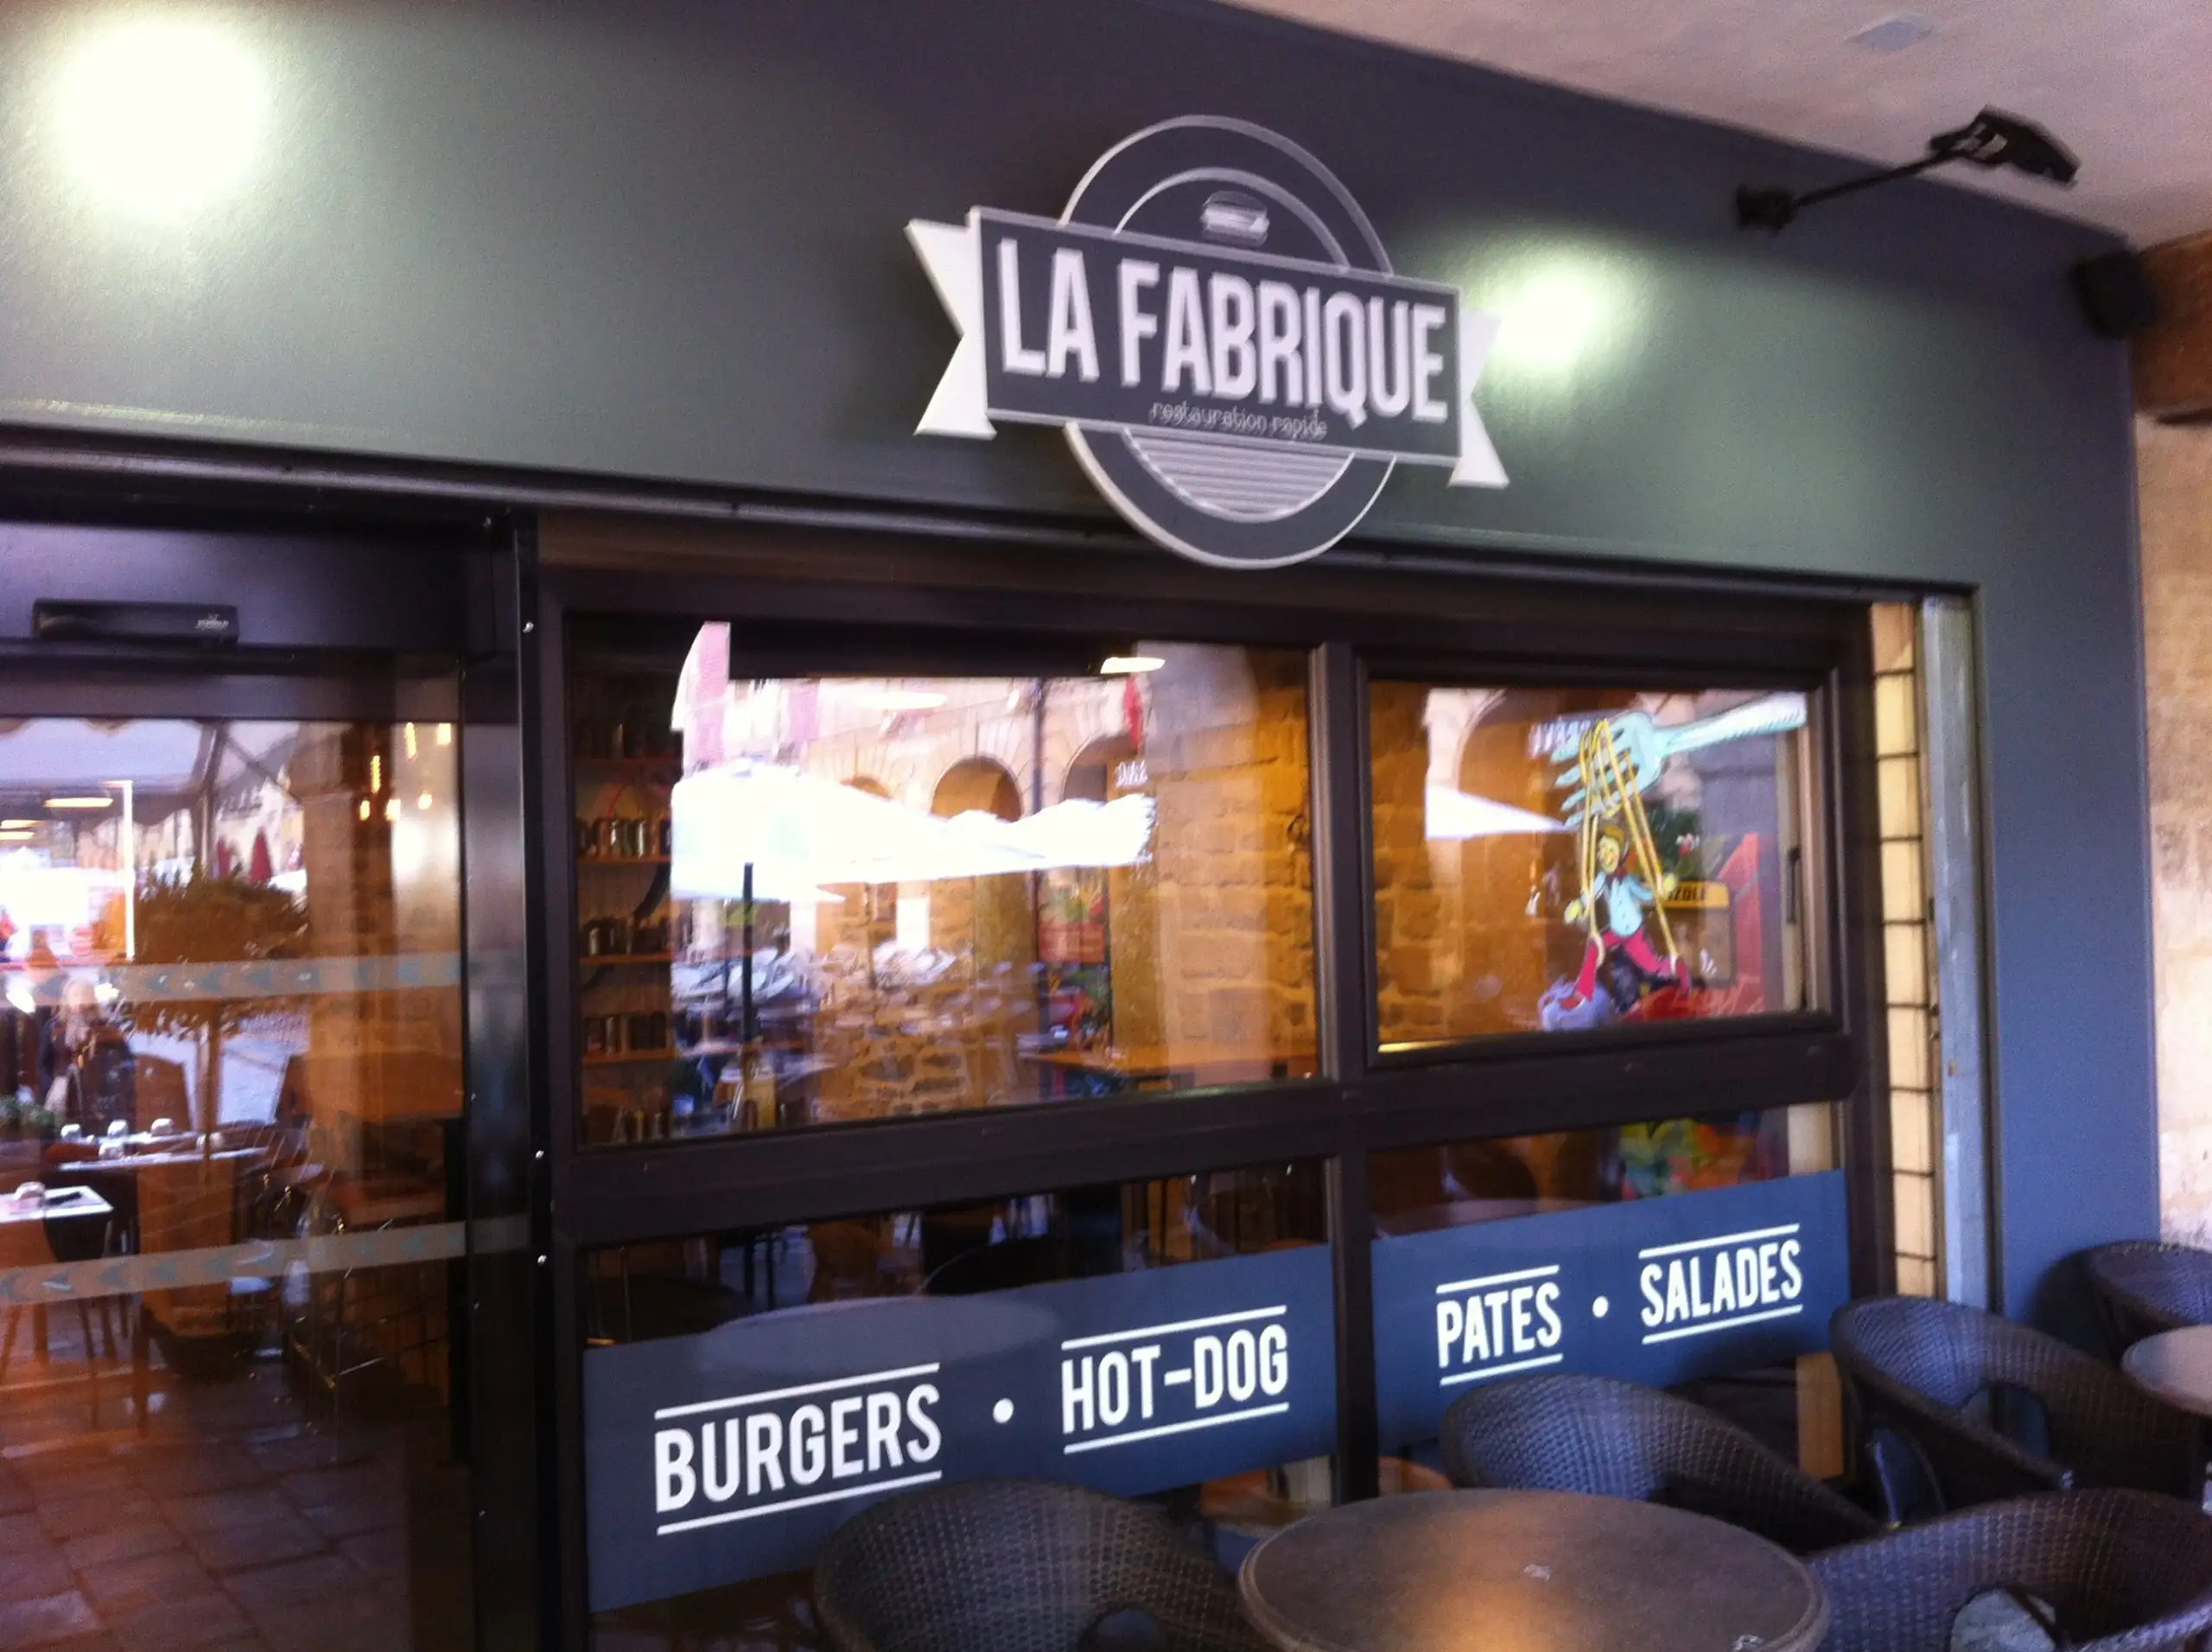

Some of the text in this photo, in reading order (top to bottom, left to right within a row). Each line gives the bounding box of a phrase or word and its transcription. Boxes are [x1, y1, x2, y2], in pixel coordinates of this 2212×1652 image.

[996, 238, 1450, 429] LA FABRIQUE
[1149, 401, 1328, 443] restauration rapide
[1435, 1238, 1803, 1369] PATES SALADES
[653, 1324, 1290, 1514] BURGERS HOT-DOG
